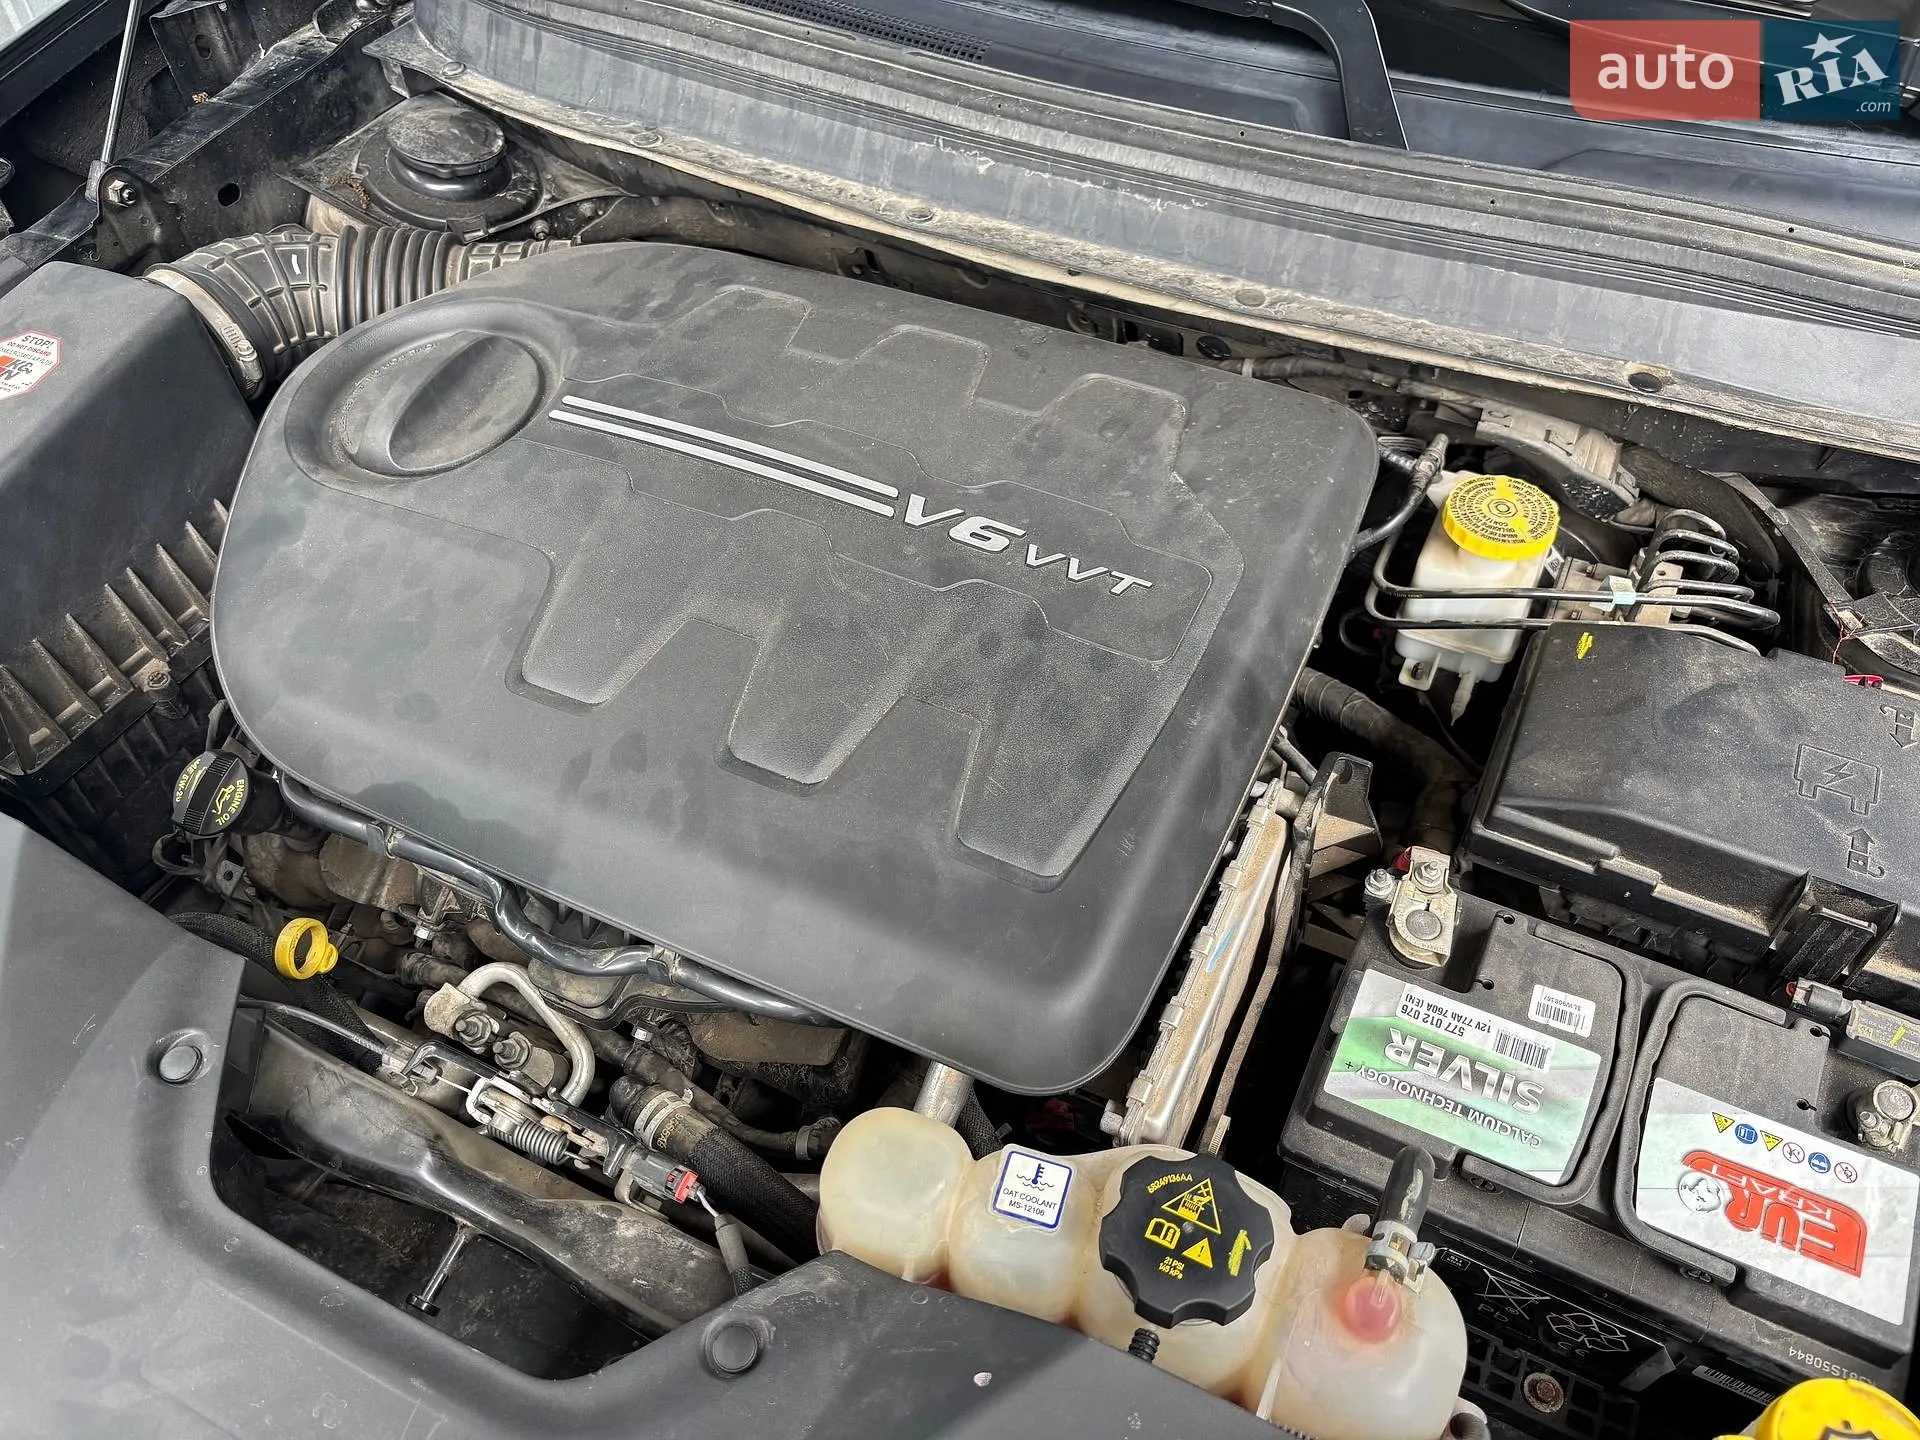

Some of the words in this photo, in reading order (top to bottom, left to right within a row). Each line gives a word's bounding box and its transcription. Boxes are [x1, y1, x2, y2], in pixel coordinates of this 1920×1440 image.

[21, 335, 54, 349] STOP!
[904, 493, 1027, 554] V6
[1025, 543, 1153, 597] VVT
[228, 778, 245, 814] ENGINE
[215, 812, 230, 826] OIL
[1405, 993, 1424, 1009] (EN)
[1400, 1004, 1421, 1020] 076
[1426, 1002, 1449, 1019] 760A
[1422, 1012, 1443, 1029] 012
[1450, 1011, 1473, 1028] 77Ah
[1475, 1021, 1491, 1033] 12V
[1444, 1022, 1465, 1038] 577
[1384, 1027, 1546, 1115] SILVER
[1355, 1064, 1464, 1120] TECHNOLOGY
[1467, 1105, 1542, 1149] CALCIUM
[1002, 1188, 1019, 1198] OAT
[1020, 1192, 1058, 1210] COOLANT
[1711, 1164, 1832, 1221] KRAFT
[1008, 1200, 1045, 1217] MS-12106
